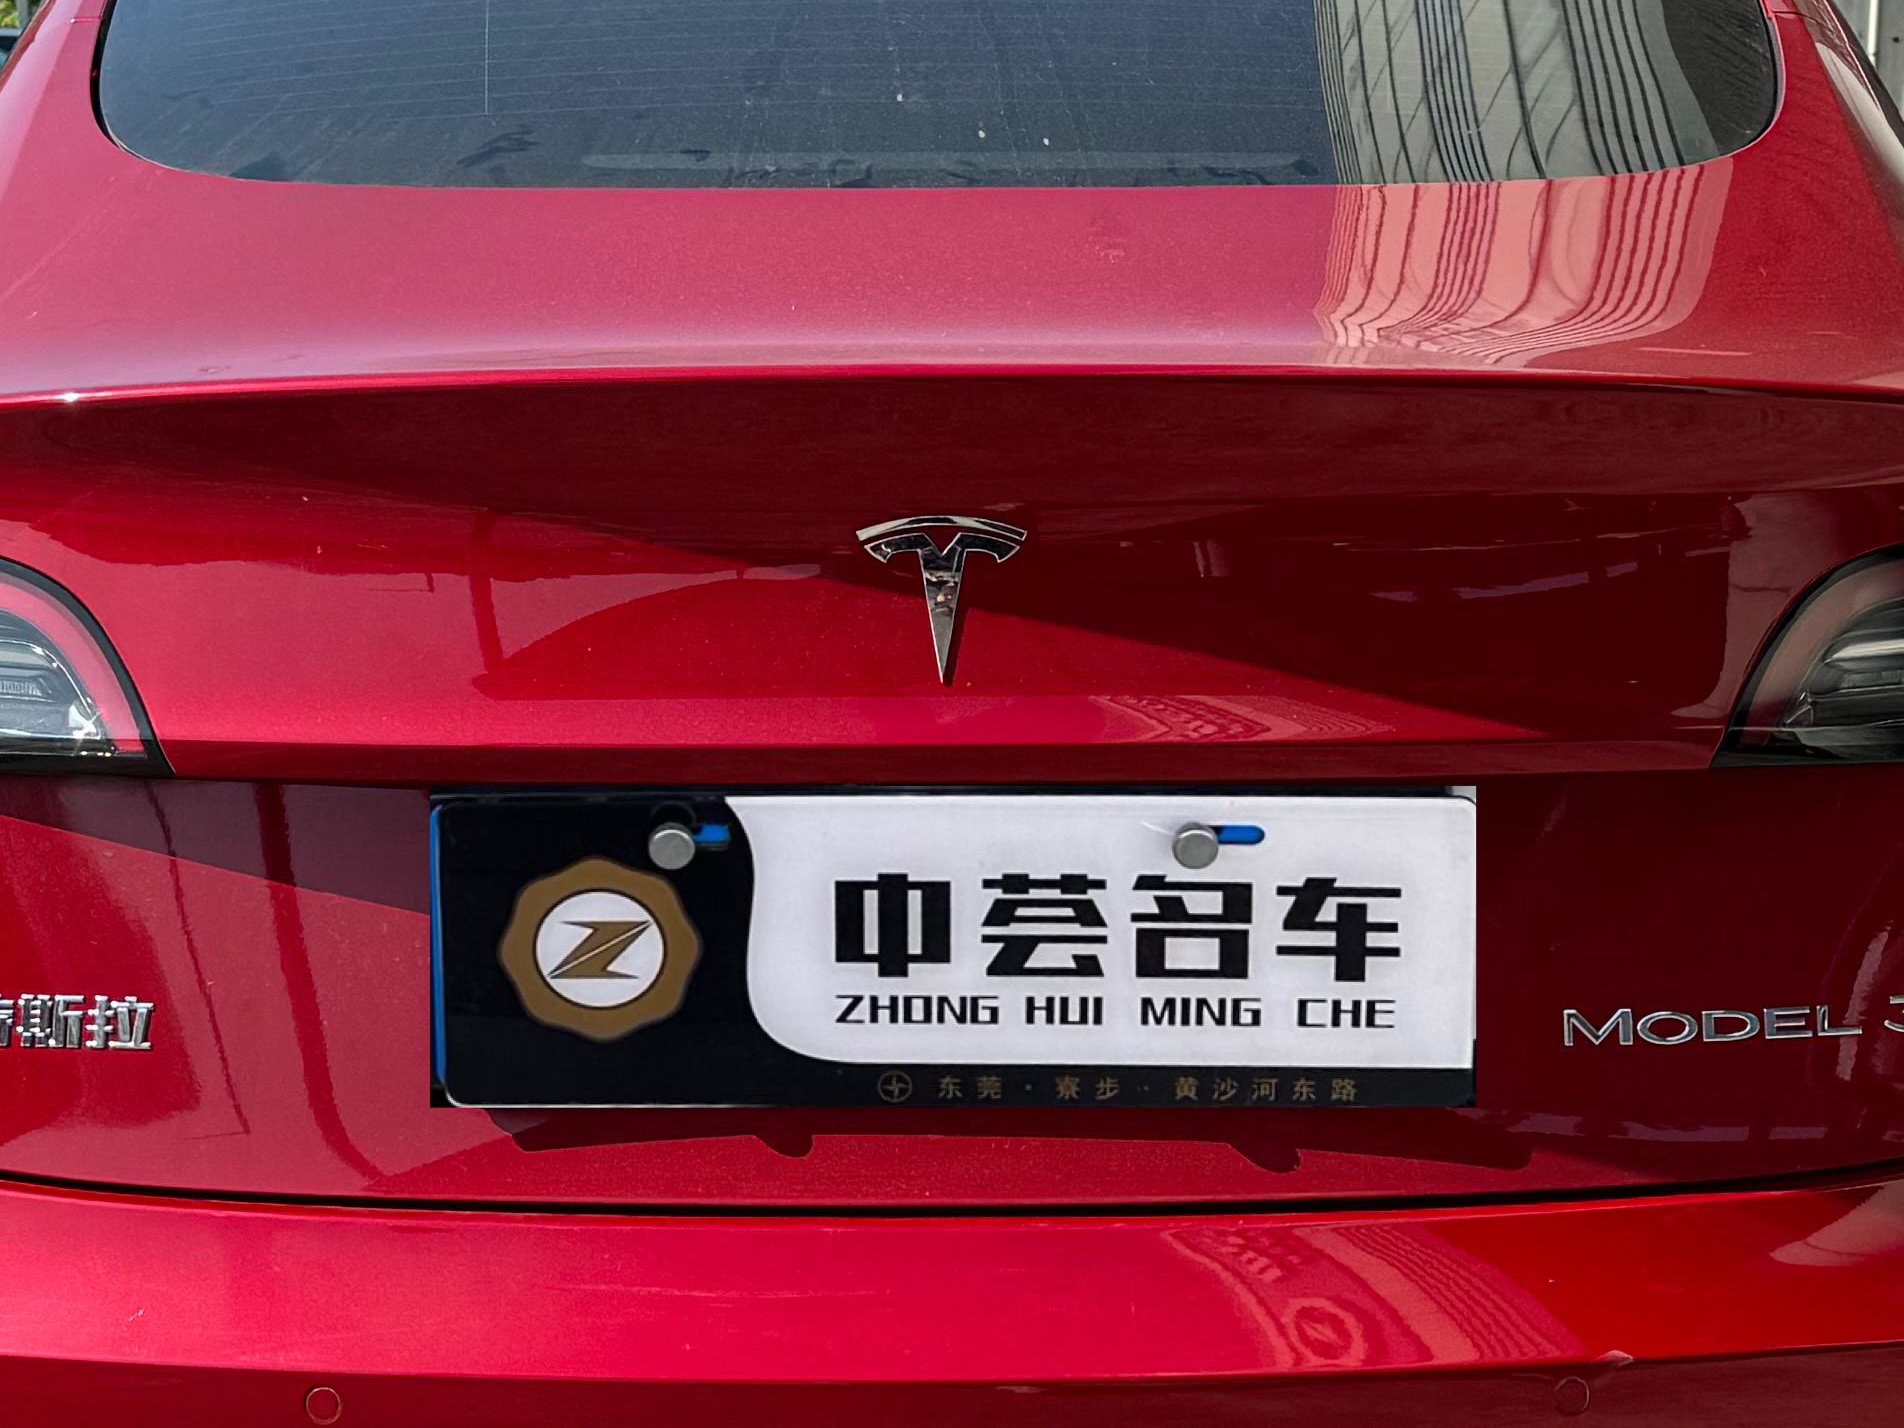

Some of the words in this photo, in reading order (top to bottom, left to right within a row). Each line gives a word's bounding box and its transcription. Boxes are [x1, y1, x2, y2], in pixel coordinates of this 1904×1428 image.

[834, 873, 1402, 982] 中荟名车
[835, 995, 999, 1025] ZHONG
[1025, 996, 1103, 1026] HUI
[1140, 997, 1262, 1027] MING
[1296, 999, 1396, 1028] CHE
[1563, 1005, 1863, 1046] MODEL
